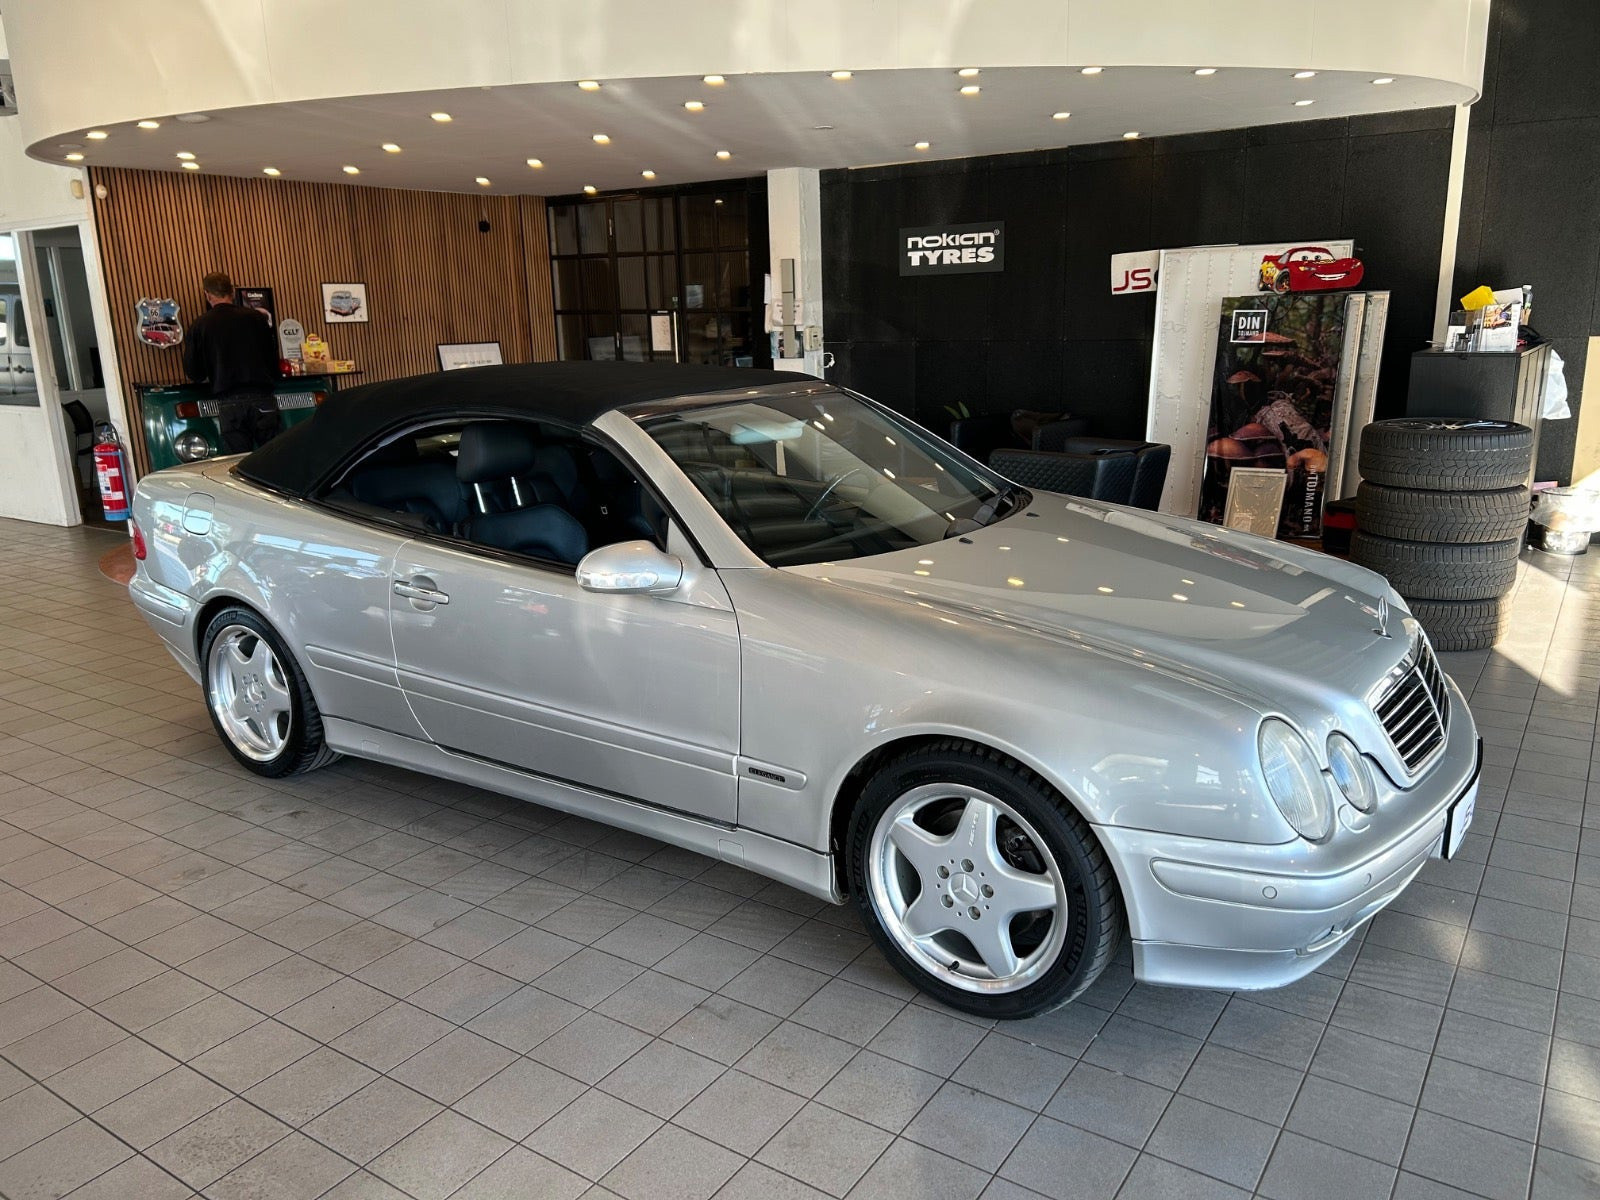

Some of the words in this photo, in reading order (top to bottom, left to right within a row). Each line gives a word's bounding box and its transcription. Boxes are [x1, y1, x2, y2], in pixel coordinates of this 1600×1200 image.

[907, 246, 995, 267] TYRES
[1113, 268, 1159, 292] JS
[150, 308, 159, 317] 66
[1238, 316, 1261, 330] DIN
[1066, 892, 1086, 973] MICHELIN
